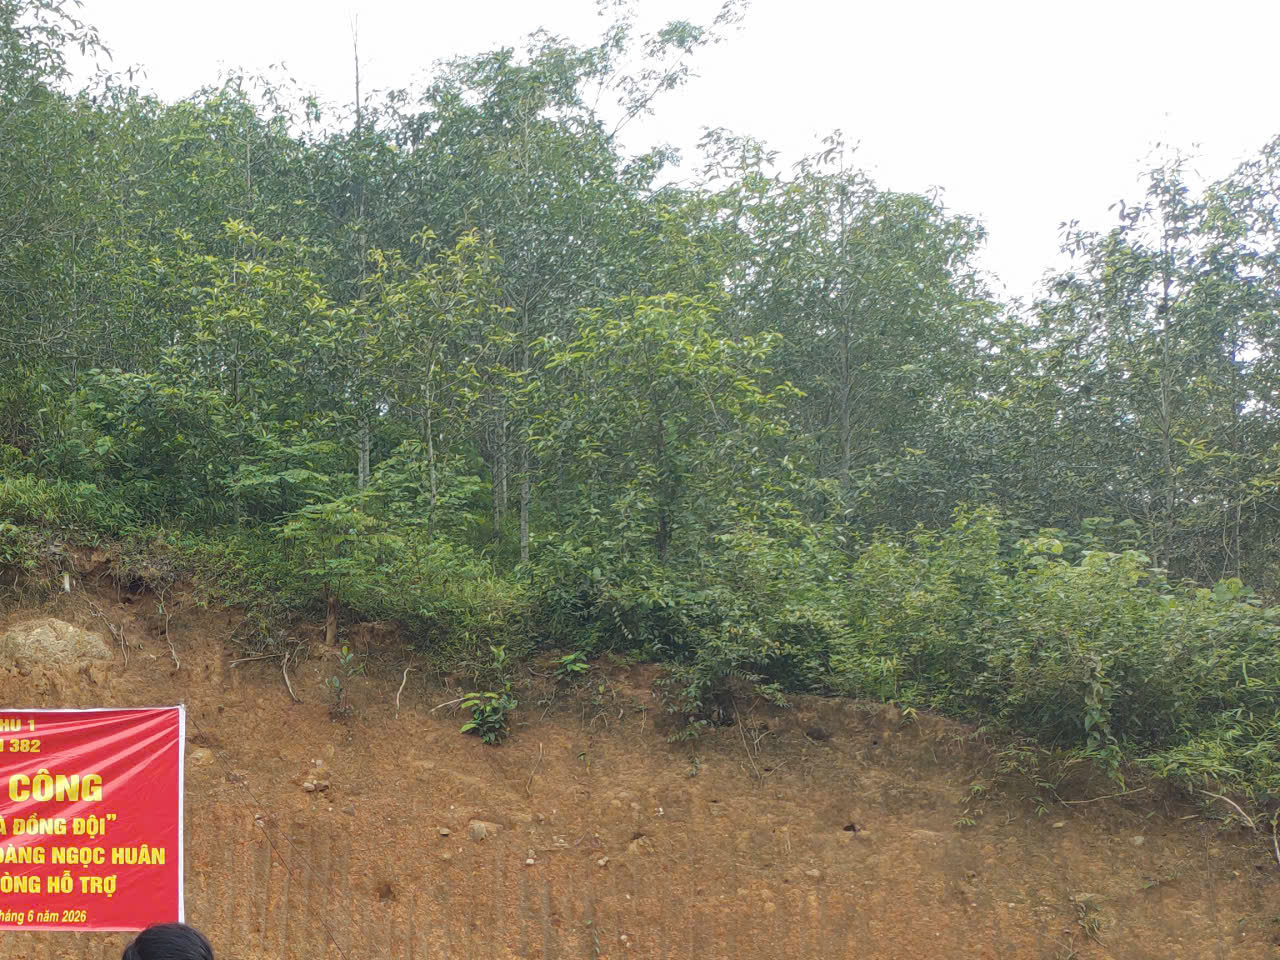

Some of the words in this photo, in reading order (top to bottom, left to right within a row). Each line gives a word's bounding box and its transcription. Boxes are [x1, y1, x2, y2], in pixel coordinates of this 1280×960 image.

[28, 719, 35, 732] 1
[10, 738, 41, 752] 382
[9, 768, 103, 802] CÔNG
[13, 813, 67, 835] ĐỒNG
[72, 813, 117, 839] ĐỘI”
[52, 846, 105, 868] NGỌC
[111, 844, 166, 865] HUÂN
[47, 870, 73, 894] HỖ
[80, 874, 117, 897] TRỢ
[27, 910, 34, 922] 6
[36, 910, 60, 922] năm
[62, 910, 87, 922] 2026
